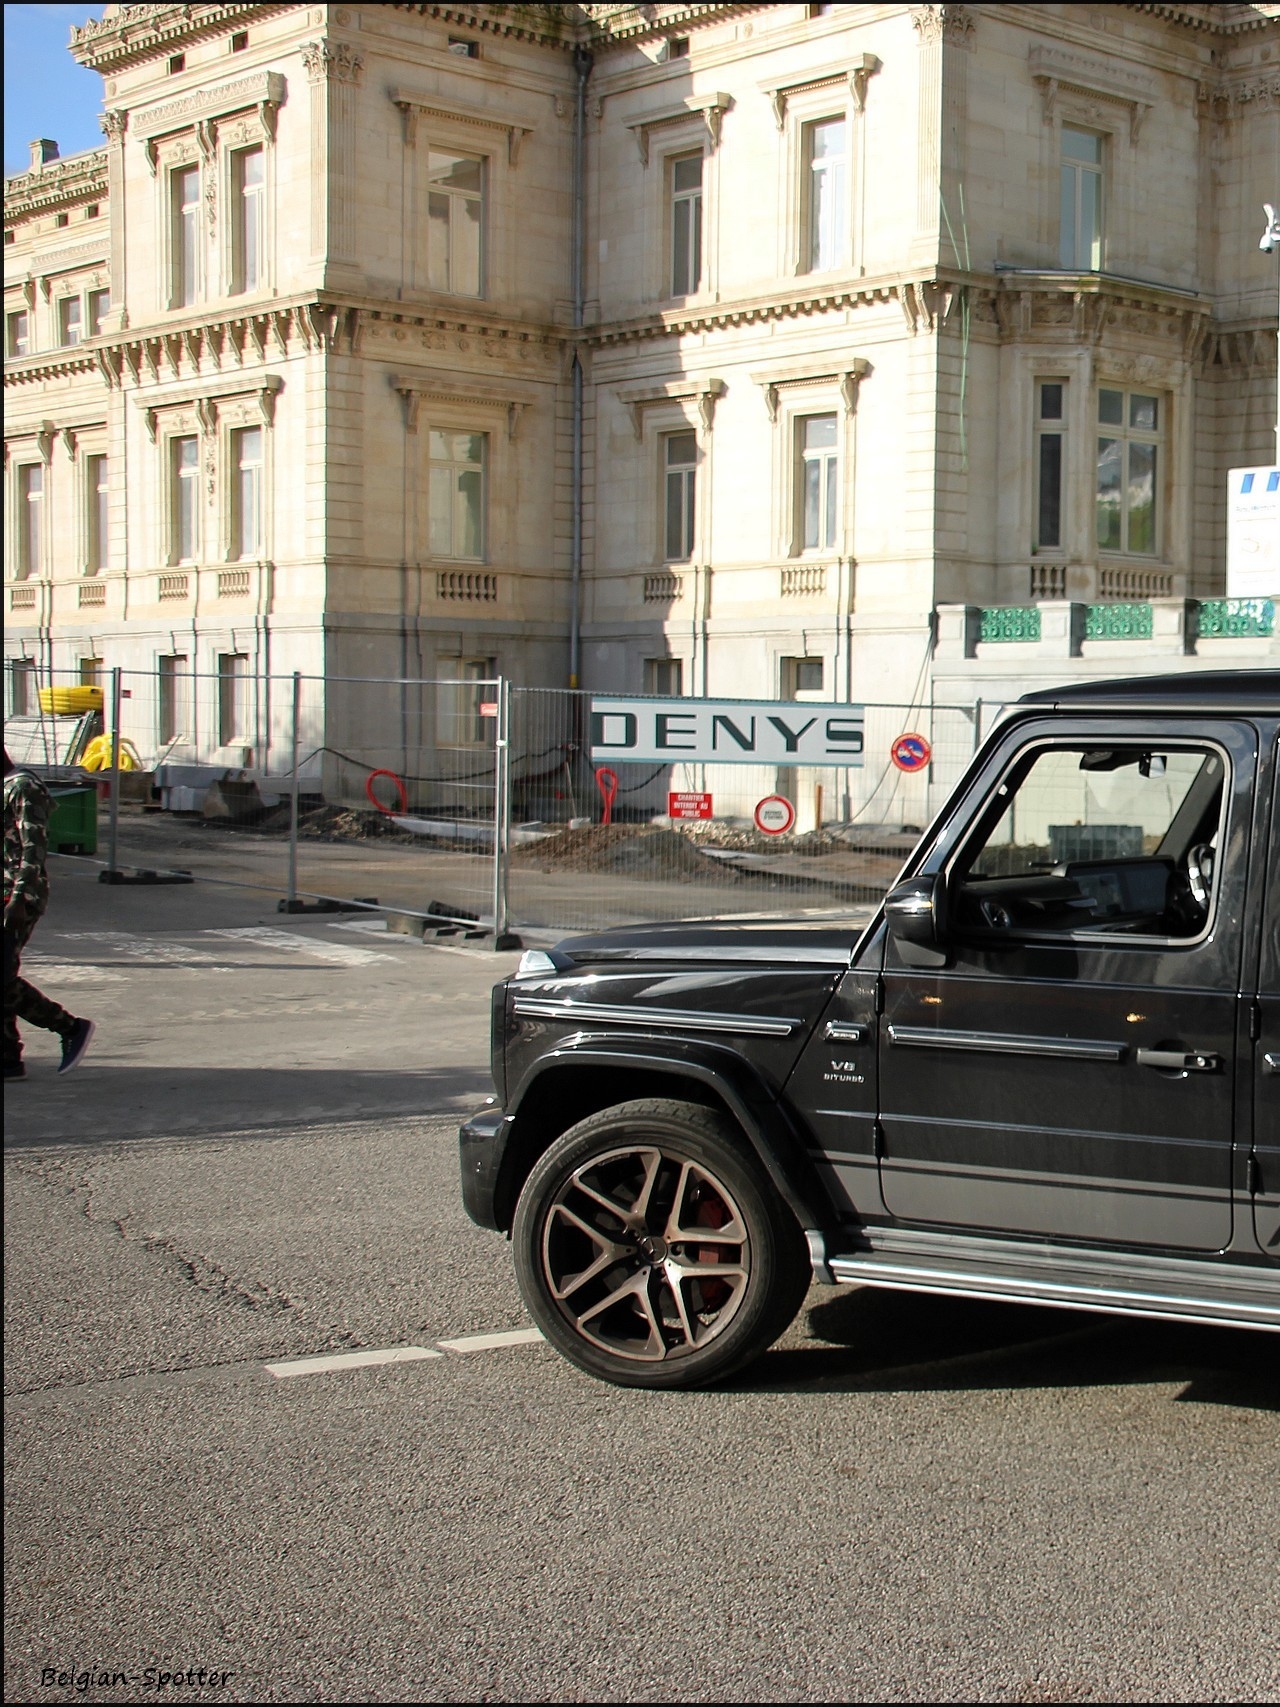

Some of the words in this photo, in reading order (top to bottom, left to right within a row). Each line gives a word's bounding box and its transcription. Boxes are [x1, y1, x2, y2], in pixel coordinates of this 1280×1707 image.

[592, 711, 865, 753] DENYS
[831, 1060, 856, 1071] V8
[824, 1073, 865, 1083] BITURBO
